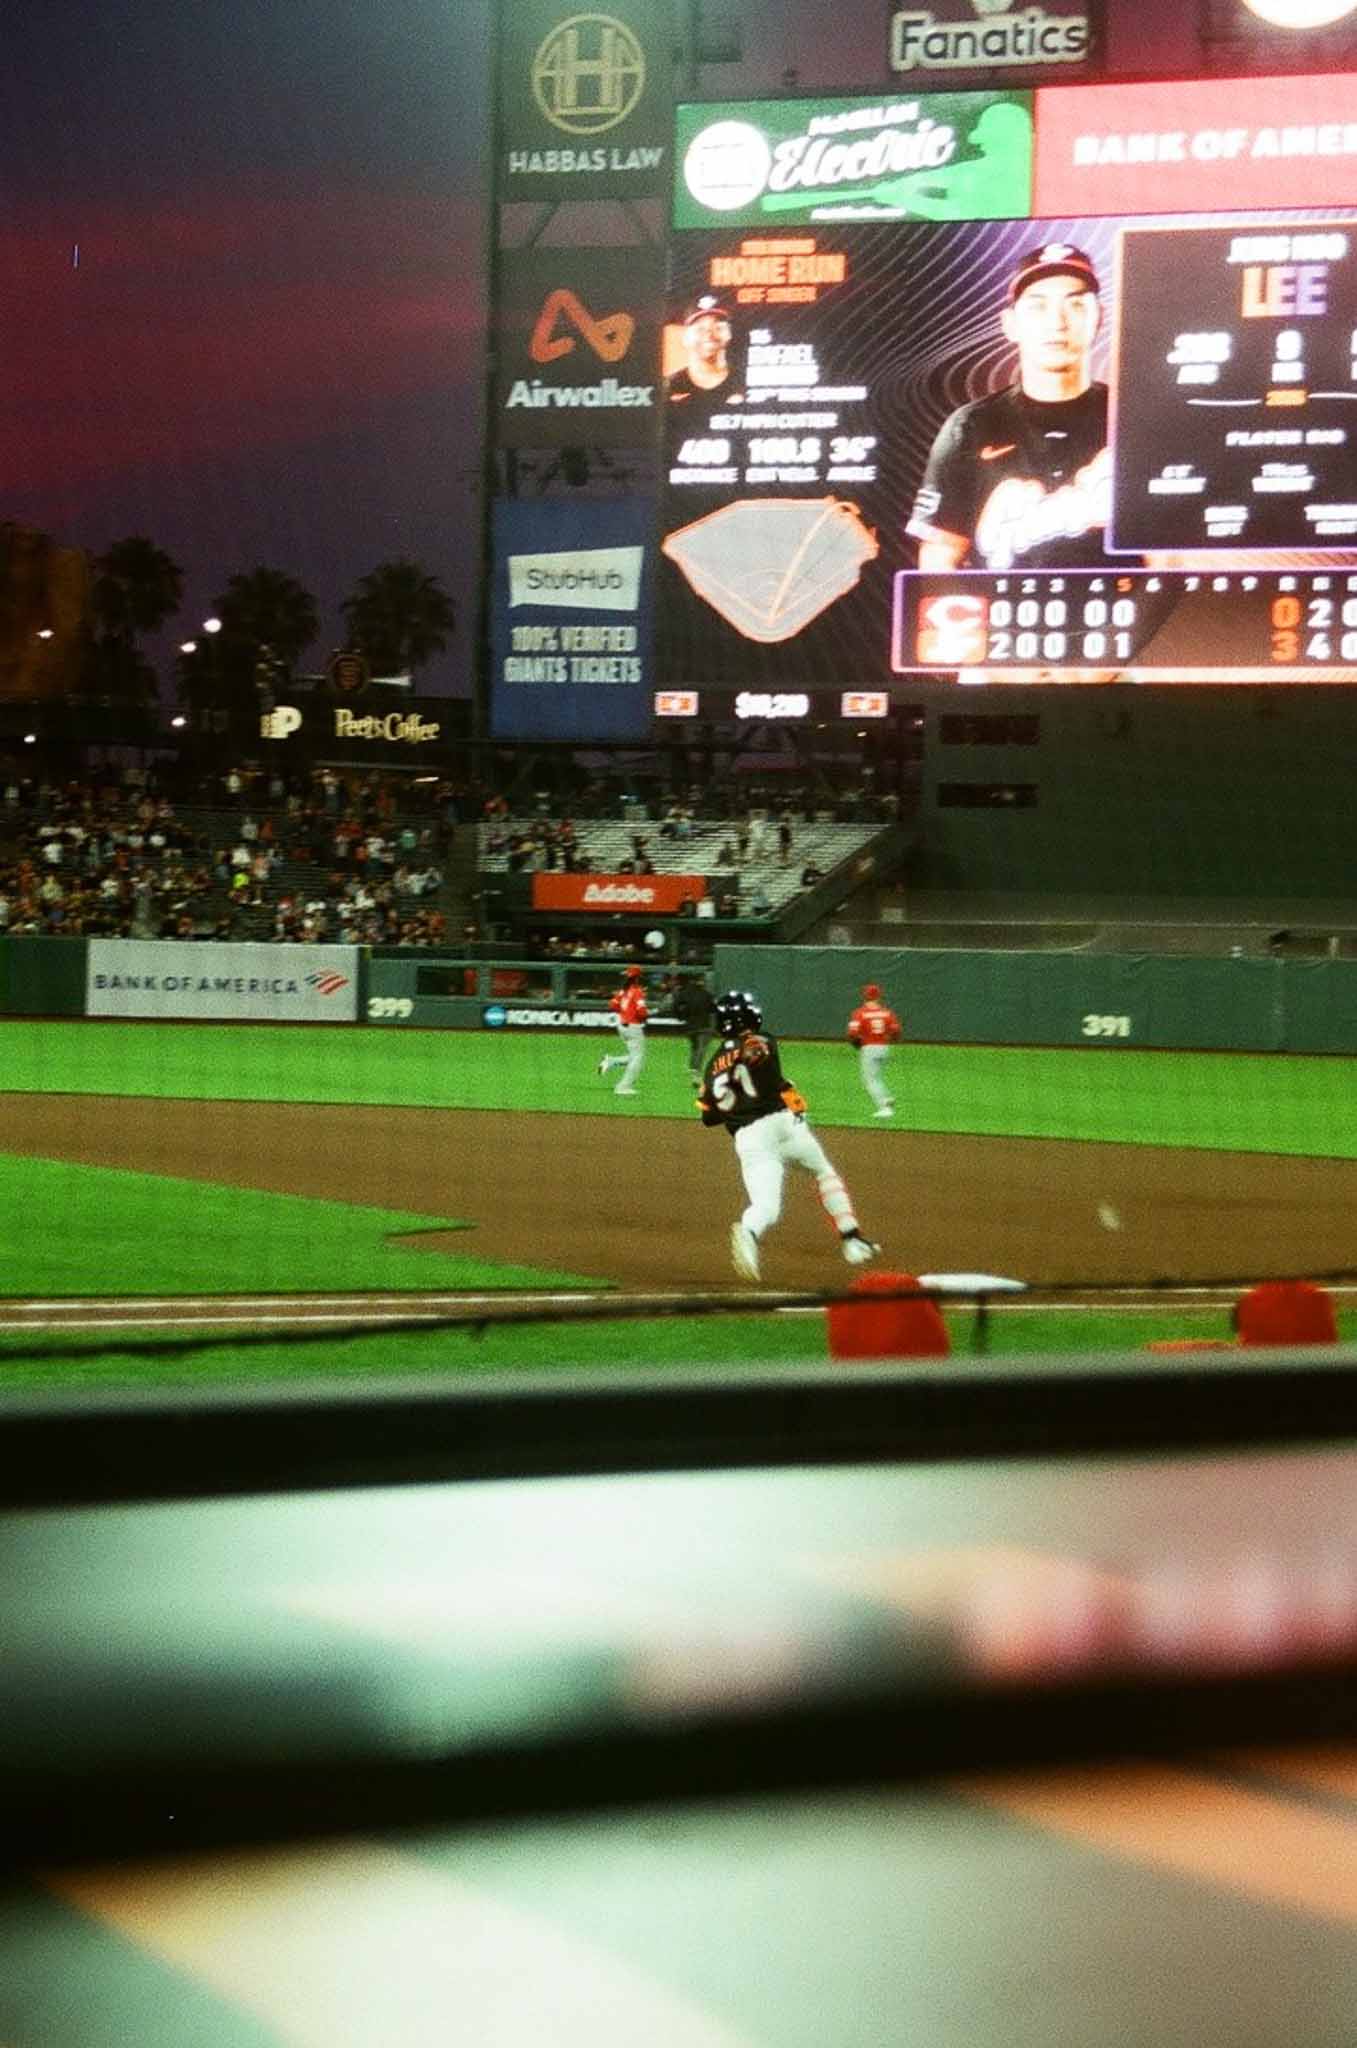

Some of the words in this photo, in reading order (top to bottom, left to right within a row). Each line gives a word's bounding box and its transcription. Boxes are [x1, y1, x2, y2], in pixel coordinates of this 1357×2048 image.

[898, 14, 1089, 62] Fanatics
[509, 148, 606, 174] HABBAS
[611, 147, 665, 171] LAW
[769, 119, 957, 191] Electric
[1072, 133, 1188, 166] BANK
[1191, 129, 1249, 160] OF
[1240, 265, 1329, 319] LEE
[506, 378, 655, 409] Airwallex
[526, 568, 624, 590] StubHub
[995, 578, 1009, 593] 1
[1021, 577, 1037, 593] 2
[1049, 577, 1066, 593] 3
[1117, 577, 1132, 592] 5
[1145, 577, 1162, 592] 6
[1241, 576, 1258, 592] 9
[989, 599, 1012, 628] 0
[1016, 599, 1039, 628] 0
[1044, 599, 1067, 628] 0
[1084, 599, 1107, 628] 0
[1112, 599, 1136, 628] 0
[1271, 596, 1301, 629] 0
[1307, 598, 1332, 628] 2
[559, 626, 637, 651] VERIFIED
[988, 631, 1012, 659] 2
[1015, 631, 1038, 659] 0
[1043, 631, 1066, 659] 0
[1083, 631, 1106, 659] 0
[1114, 631, 1130, 658] 1
[1271, 630, 1299, 661] 3
[1306, 632, 1331, 660] 4
[504, 656, 568, 683] GIANTS
[569, 656, 643, 683] TICKETS
[384, 713, 440, 744] Coffee
[583, 884, 654, 903] Adobe
[95, 974, 159, 992] BANK
[162, 975, 194, 992] OF
[198, 976, 299, 995] AMERICA
[368, 998, 414, 1018] 399
[573, 1011, 622, 1027] MINO
[1082, 1014, 1131, 1037] 391
[713, 1063, 758, 1111] 51
